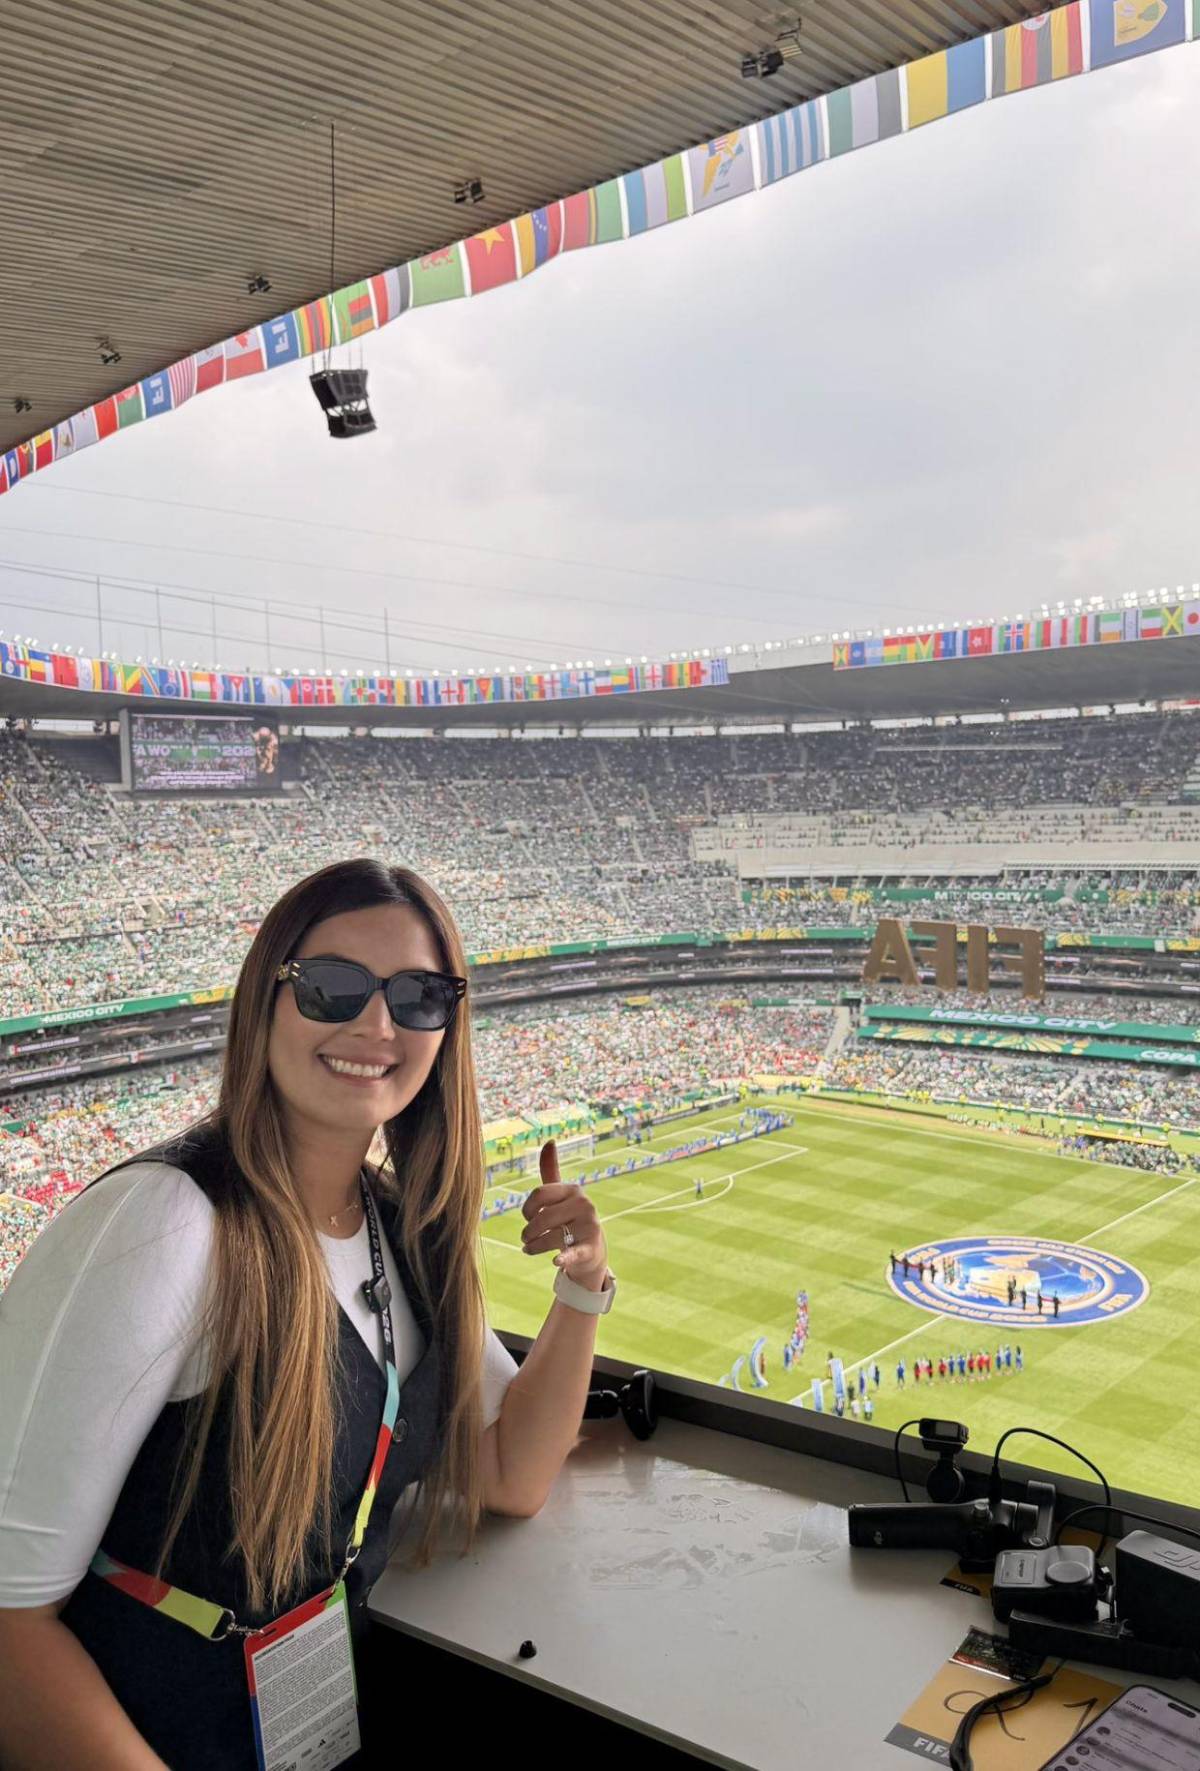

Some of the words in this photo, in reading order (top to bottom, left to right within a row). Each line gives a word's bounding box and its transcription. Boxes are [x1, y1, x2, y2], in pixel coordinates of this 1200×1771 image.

[44, 1008, 93, 1023] MEXICO
[95, 1004, 125, 1015] CITY
[929, 1008, 1041, 1026] MEXICO
[1044, 1017, 1118, 1031] CITY
[1140, 1050, 1197, 1064] COPA
[373, 1252, 384, 1277] CU
